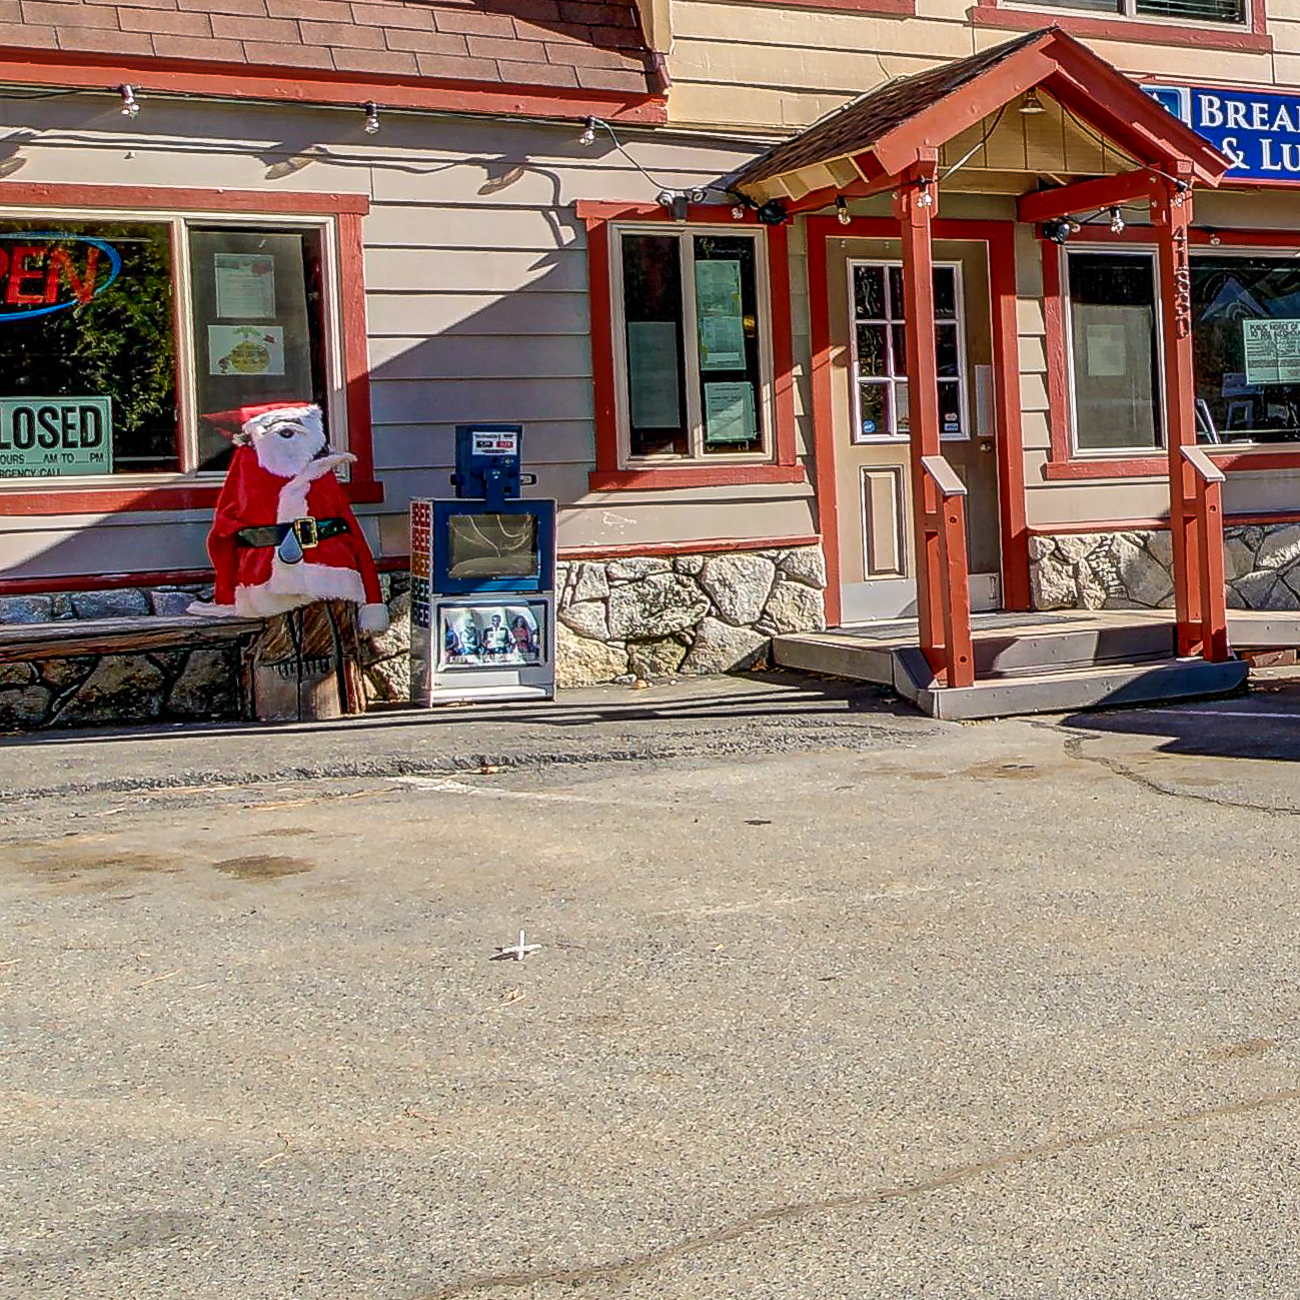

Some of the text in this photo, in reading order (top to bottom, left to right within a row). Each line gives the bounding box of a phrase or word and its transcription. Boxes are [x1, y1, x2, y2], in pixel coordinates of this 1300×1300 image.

[1221, 137, 1250, 170] &
[0, 246, 100, 305] EN
[43, 453, 57, 464] AM
[61, 453, 75, 464] TO
[89, 452, 104, 463] PM
